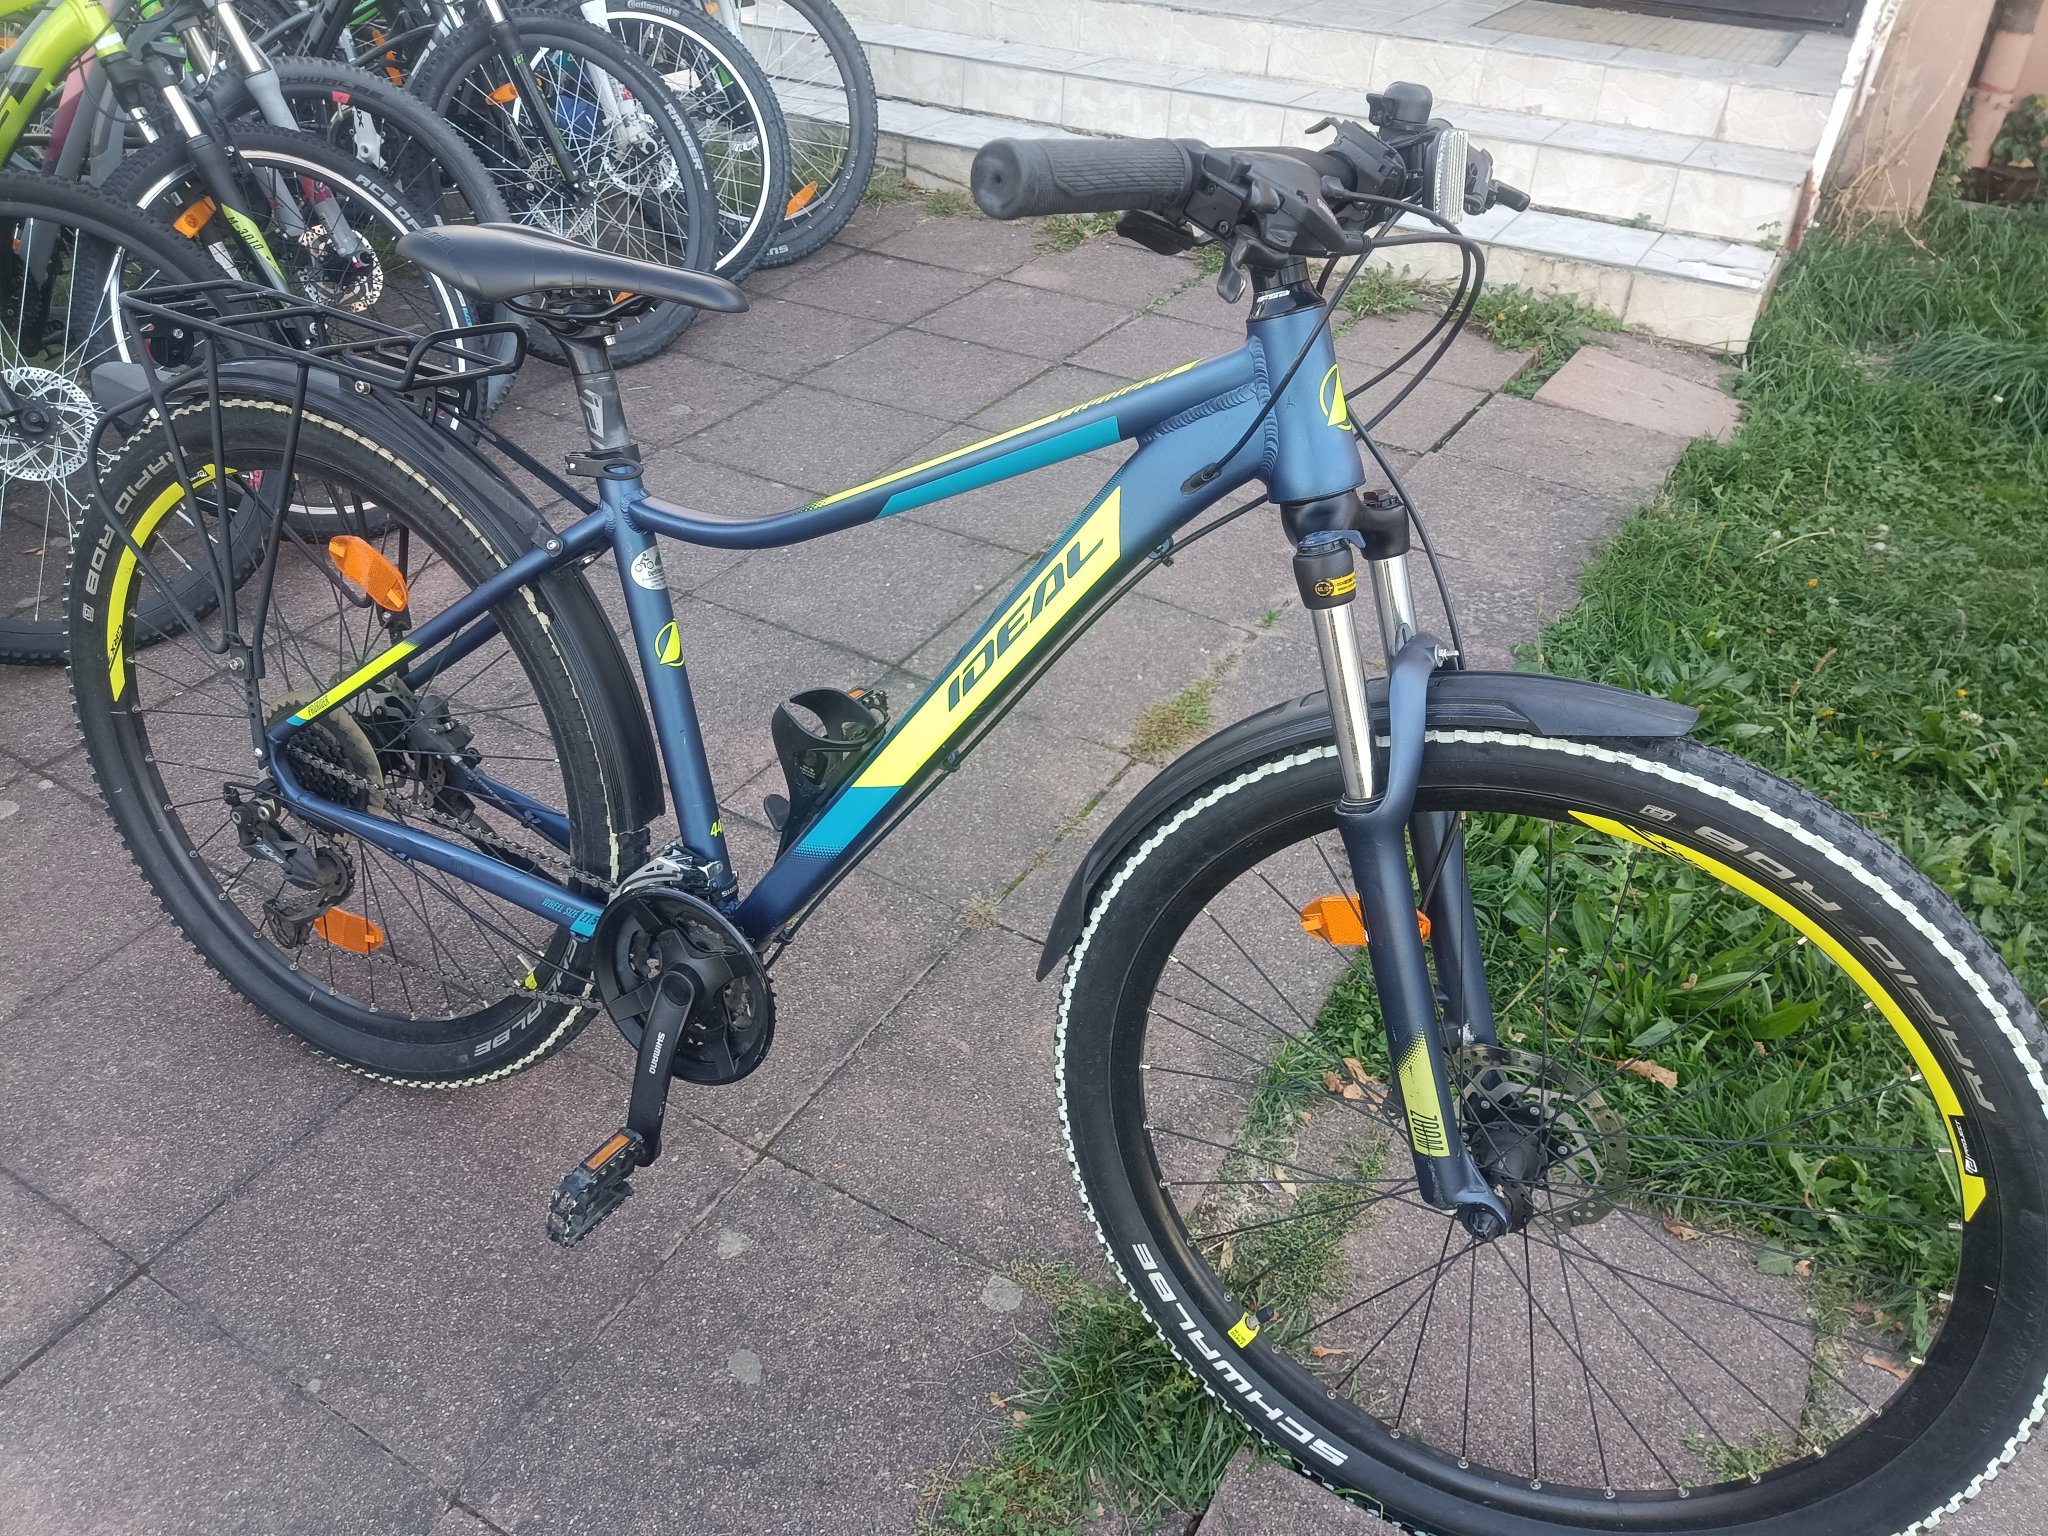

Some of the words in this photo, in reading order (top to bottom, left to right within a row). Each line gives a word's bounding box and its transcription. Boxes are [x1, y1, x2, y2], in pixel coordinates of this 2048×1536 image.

[664, 103, 702, 170] RANGER
[355, 174, 398, 207] ACE
[85, 524, 116, 596] ROB
[948, 537, 1104, 713] IDEAL
[1694, 826, 1843, 911] ROB
[541, 897, 565, 913] WHEEL
[563, 907, 581, 919] SIZE
[649, 1031, 666, 1075] SHIMANO
[1859, 936, 1997, 1113] RAPID
[1410, 1109, 1444, 1151] ZOOM
[1954, 1119, 1973, 1157] PROJECT
[1132, 1243, 1349, 1467] SCHWALBE
